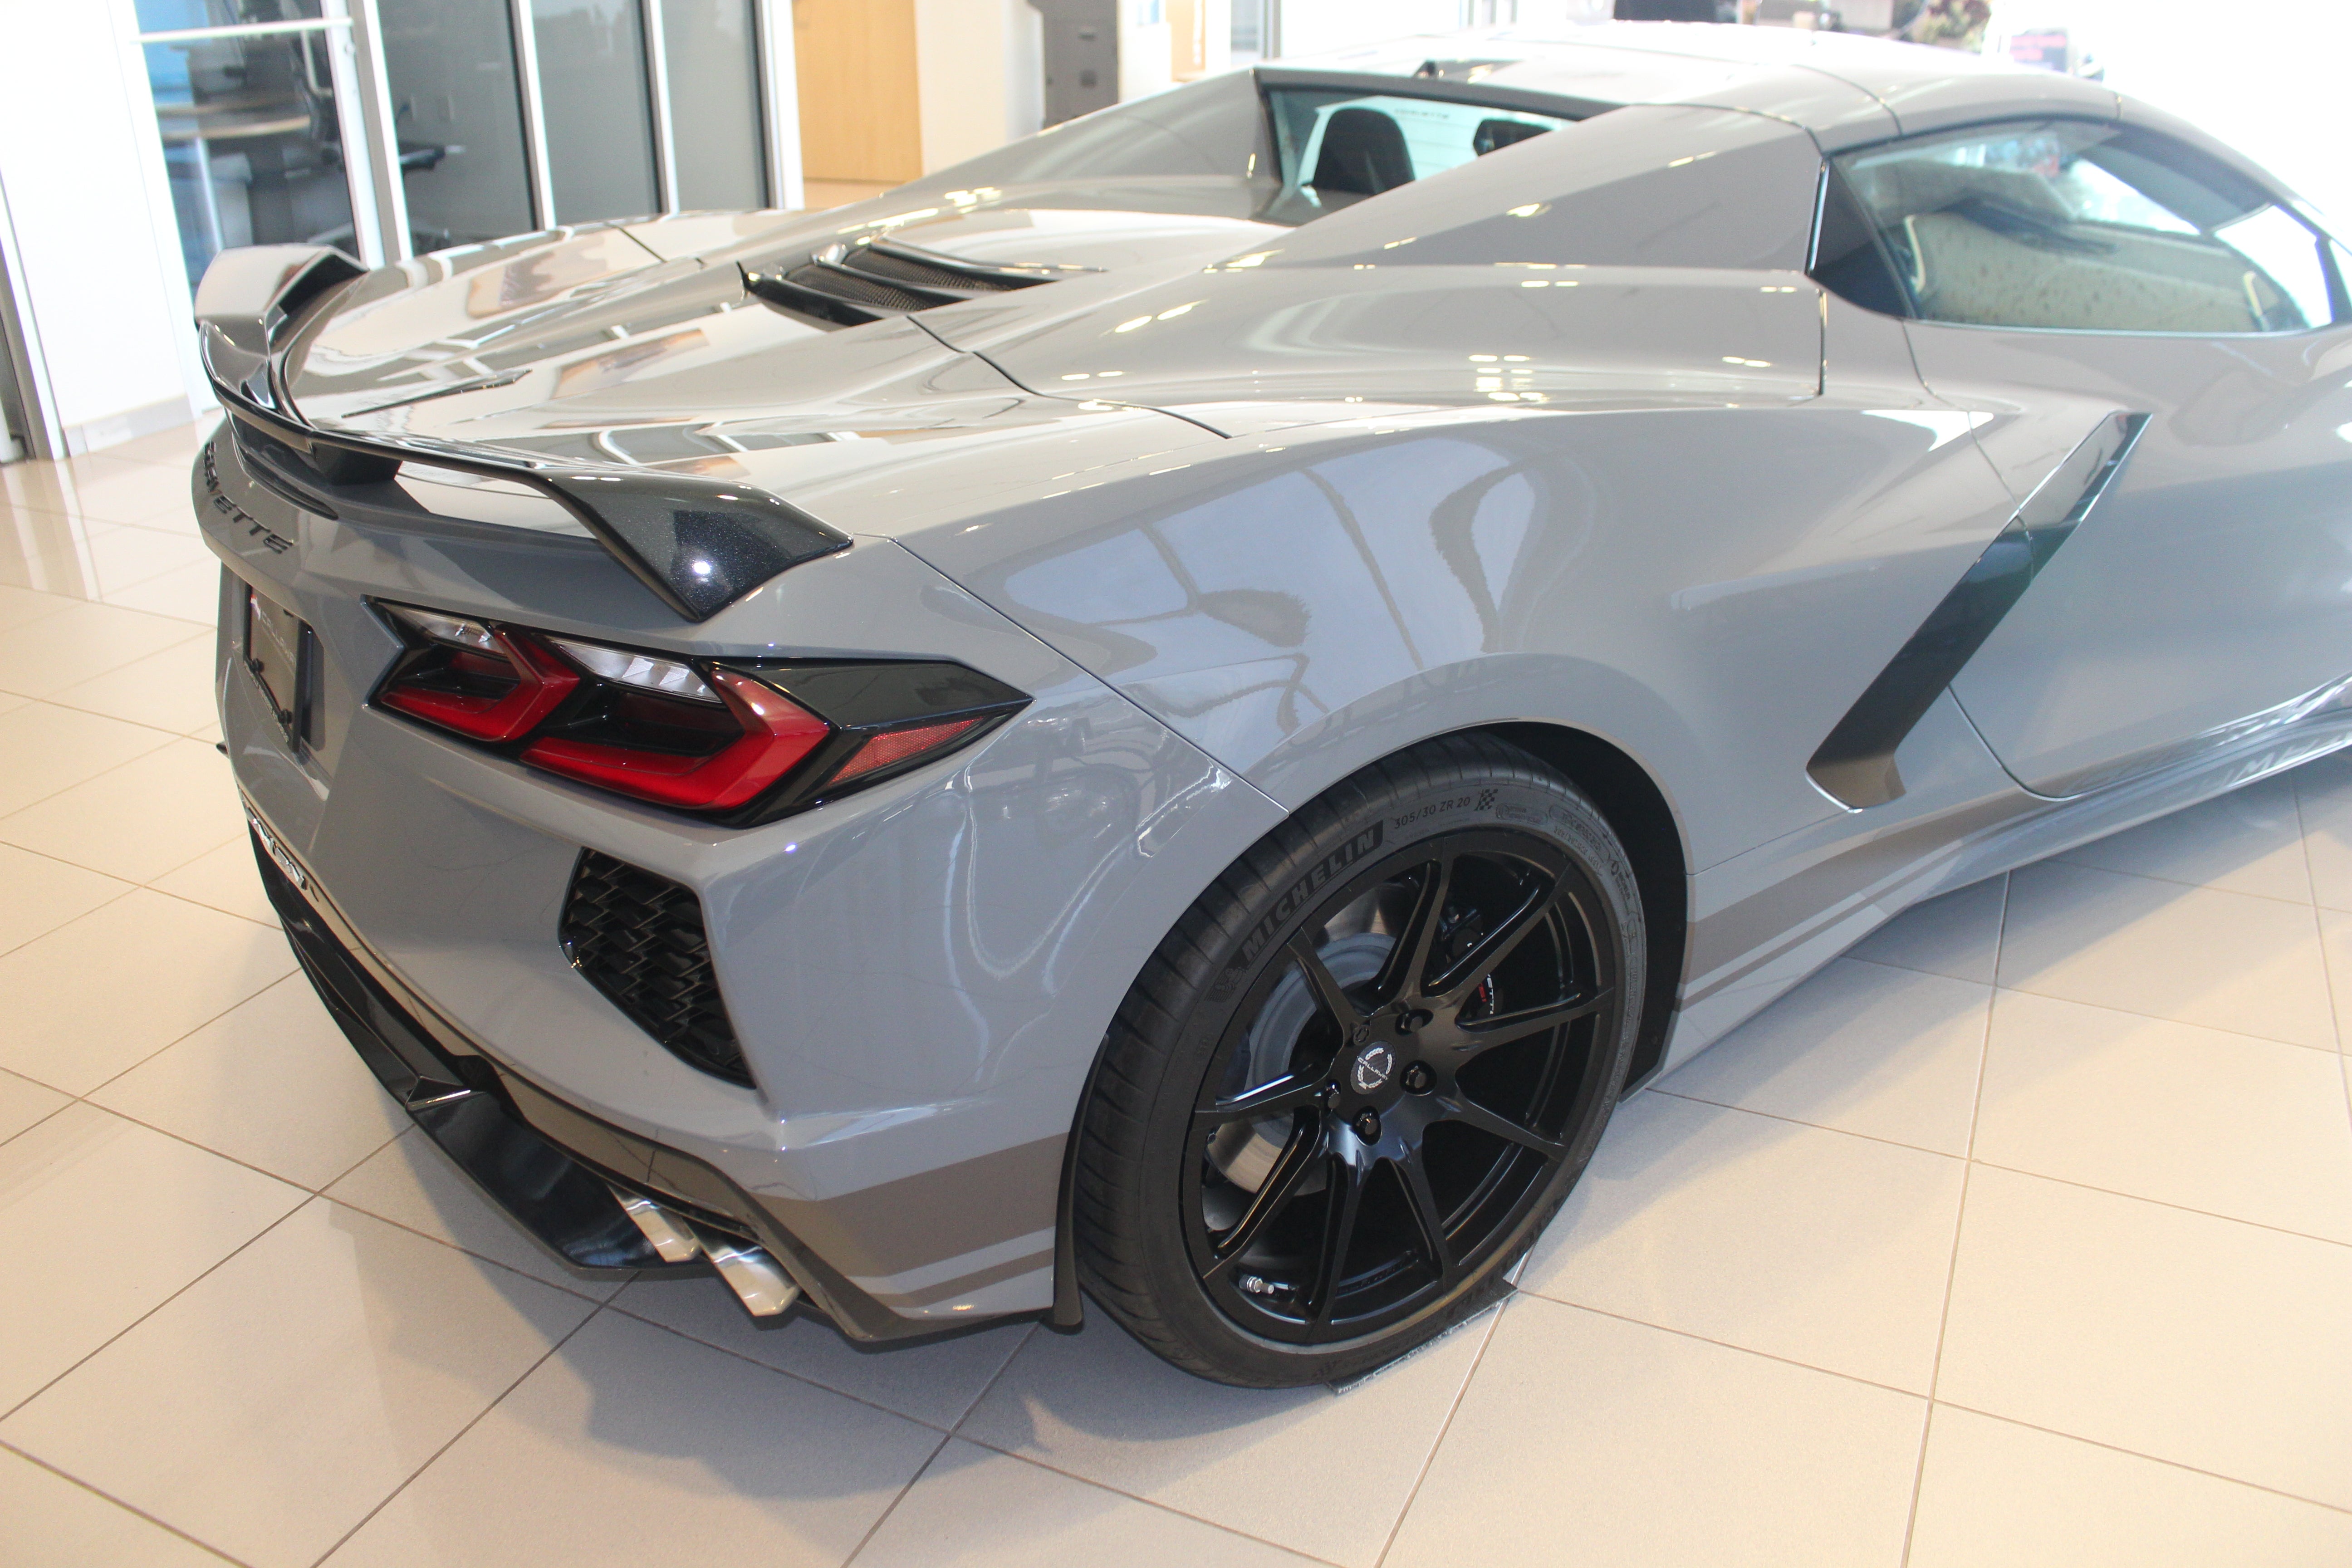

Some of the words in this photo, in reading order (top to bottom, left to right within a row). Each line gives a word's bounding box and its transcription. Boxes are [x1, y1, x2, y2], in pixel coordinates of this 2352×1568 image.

[1394, 805, 1436, 829] 305/30
[1439, 799, 1454, 813] ZR
[1456, 797, 1470, 808] 20
[1241, 828, 1374, 963] MICHELIN
[1357, 1057, 1389, 1080] CALLAWAY
